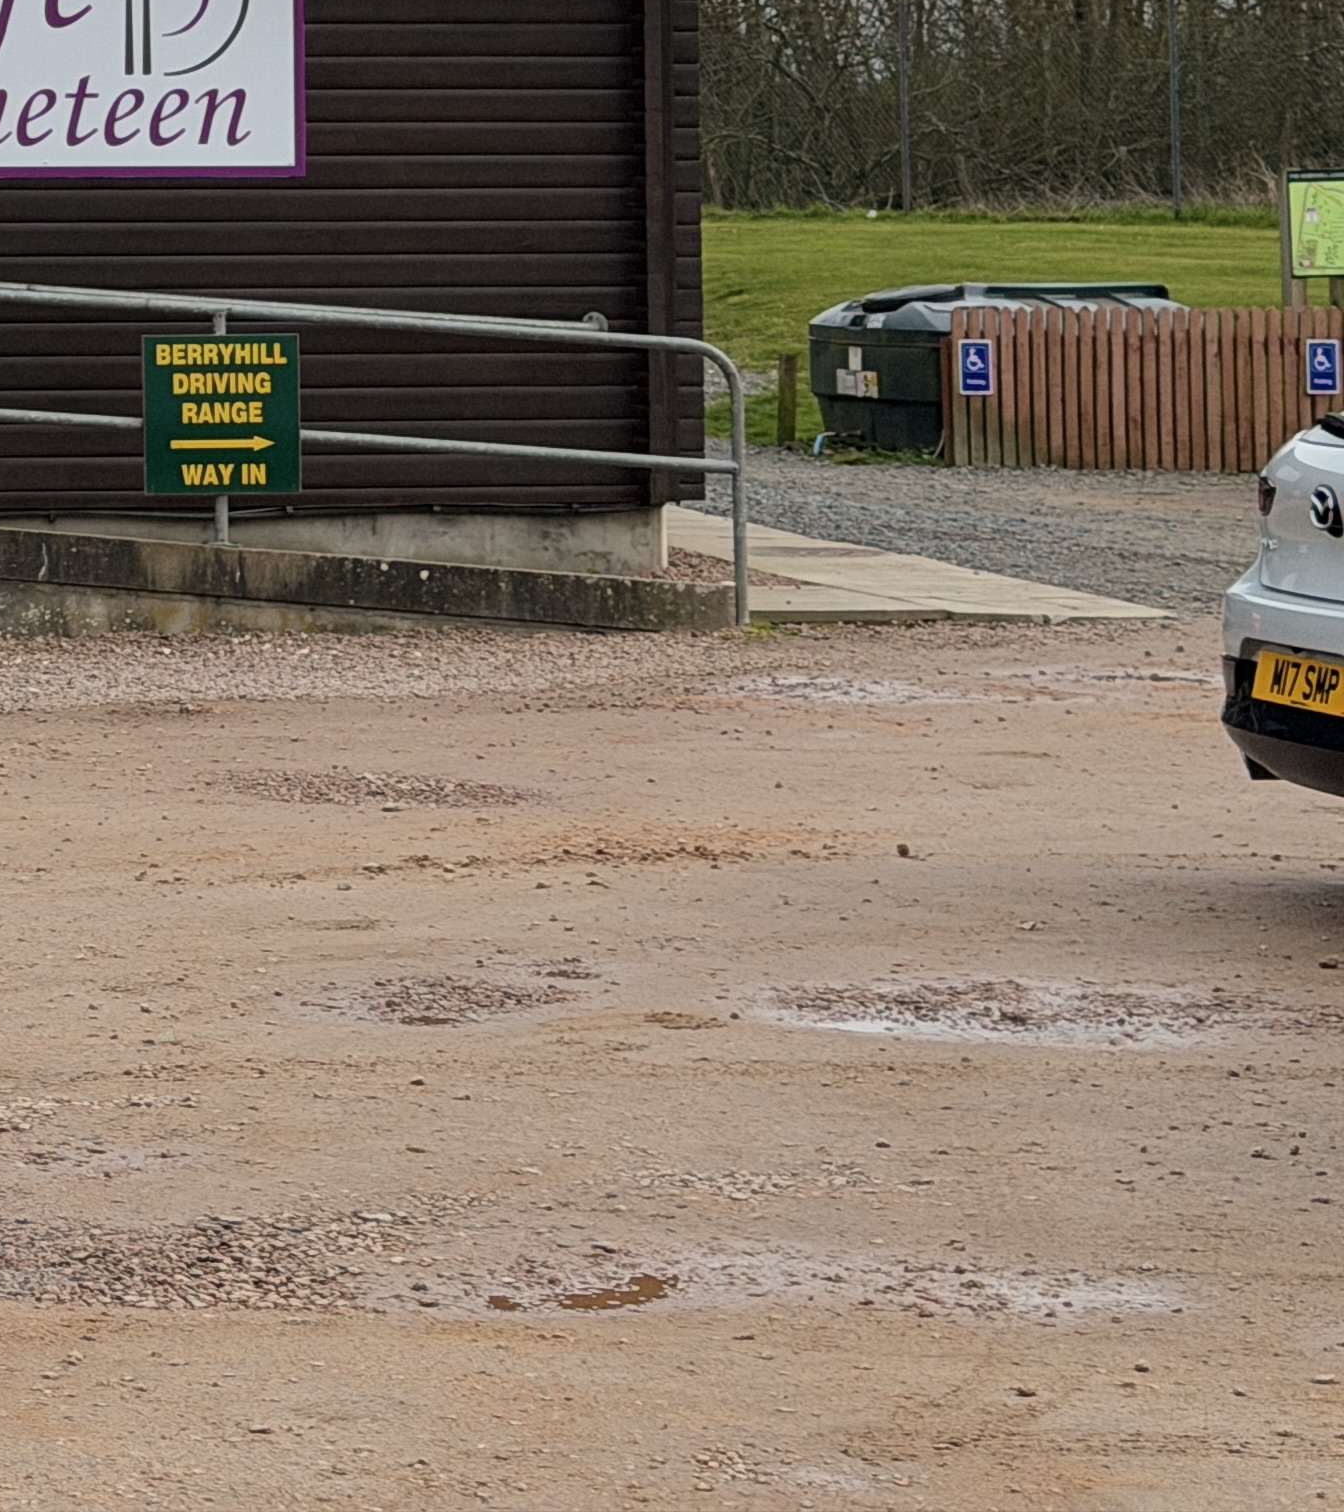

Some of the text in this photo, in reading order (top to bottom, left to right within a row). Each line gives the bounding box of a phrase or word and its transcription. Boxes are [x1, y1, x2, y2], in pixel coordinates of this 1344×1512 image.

[155, 343, 288, 366] BERRYHILL
[172, 372, 272, 395] DRIVING
[182, 402, 264, 425] RANGE
[181, 463, 267, 486] WAY IN
[1269, 657, 1341, 706] M17 SMP
